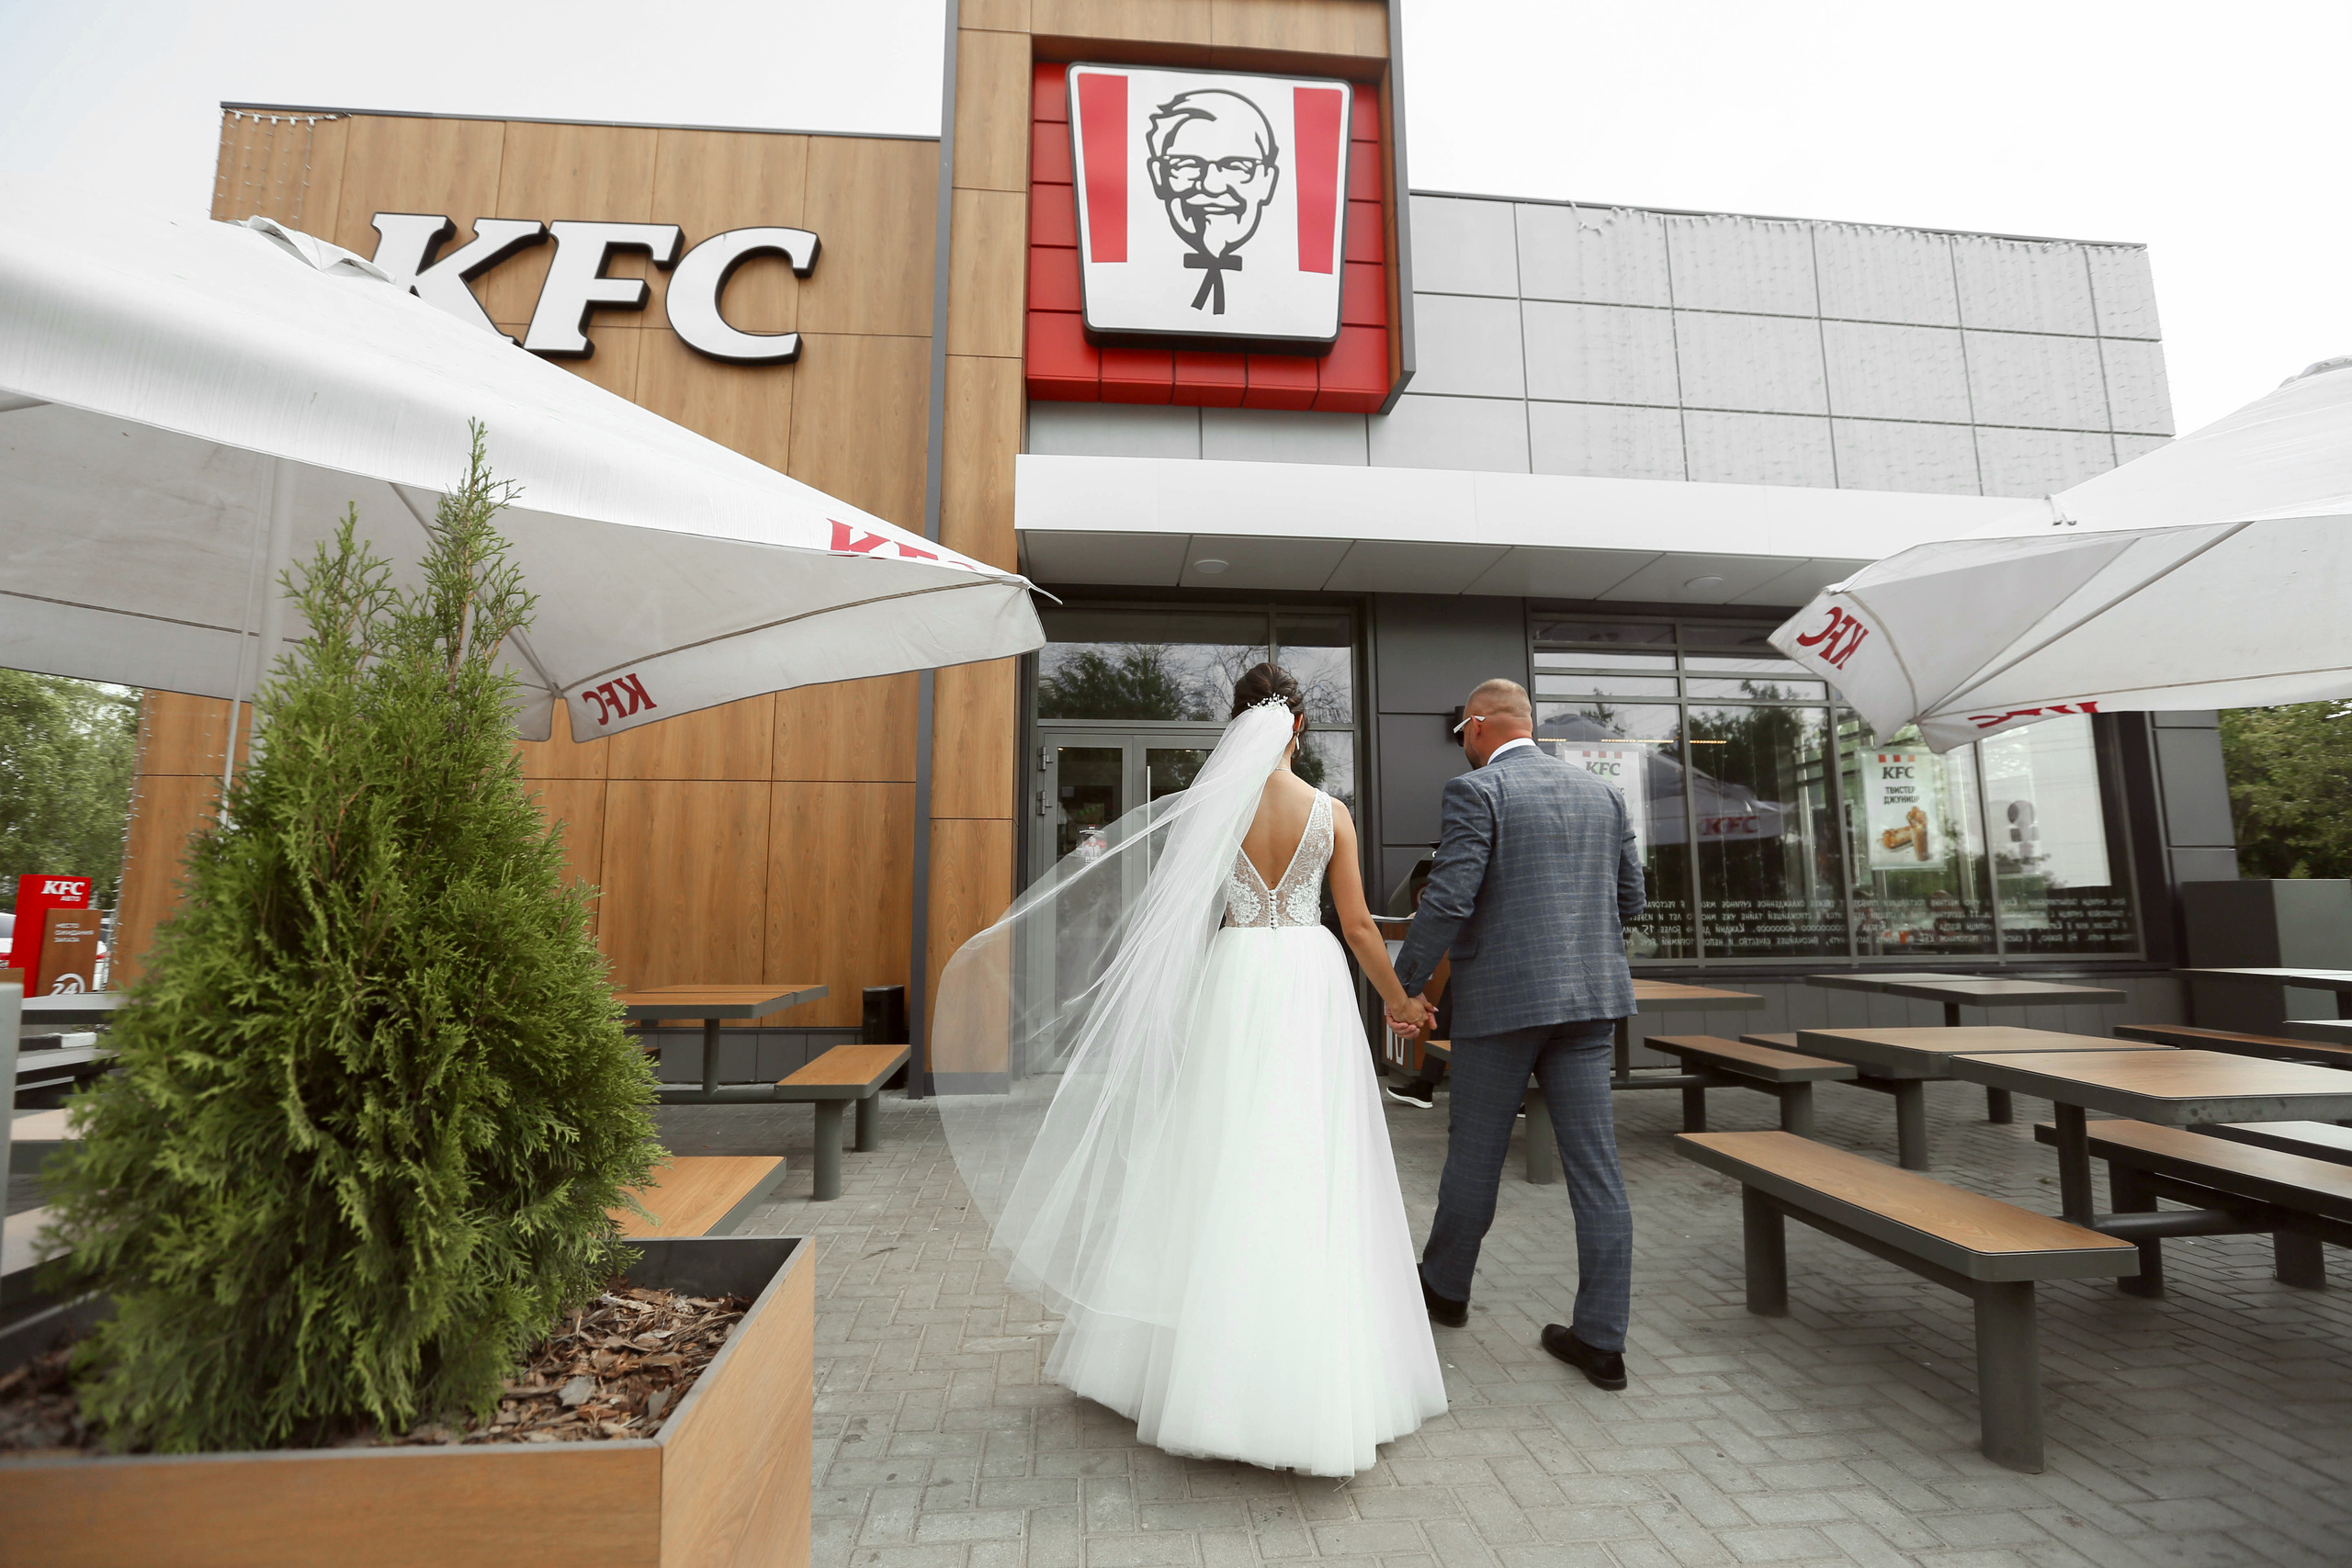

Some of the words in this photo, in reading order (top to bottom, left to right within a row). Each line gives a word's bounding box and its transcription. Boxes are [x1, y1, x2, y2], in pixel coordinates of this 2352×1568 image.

[371, 211, 822, 366] KFC
[1586, 761, 1622, 776] KFC
[1883, 766, 1915, 779] KFC
[1884, 795, 1920, 805] ДЖУНИОР
[41, 880, 85, 896] KFC
